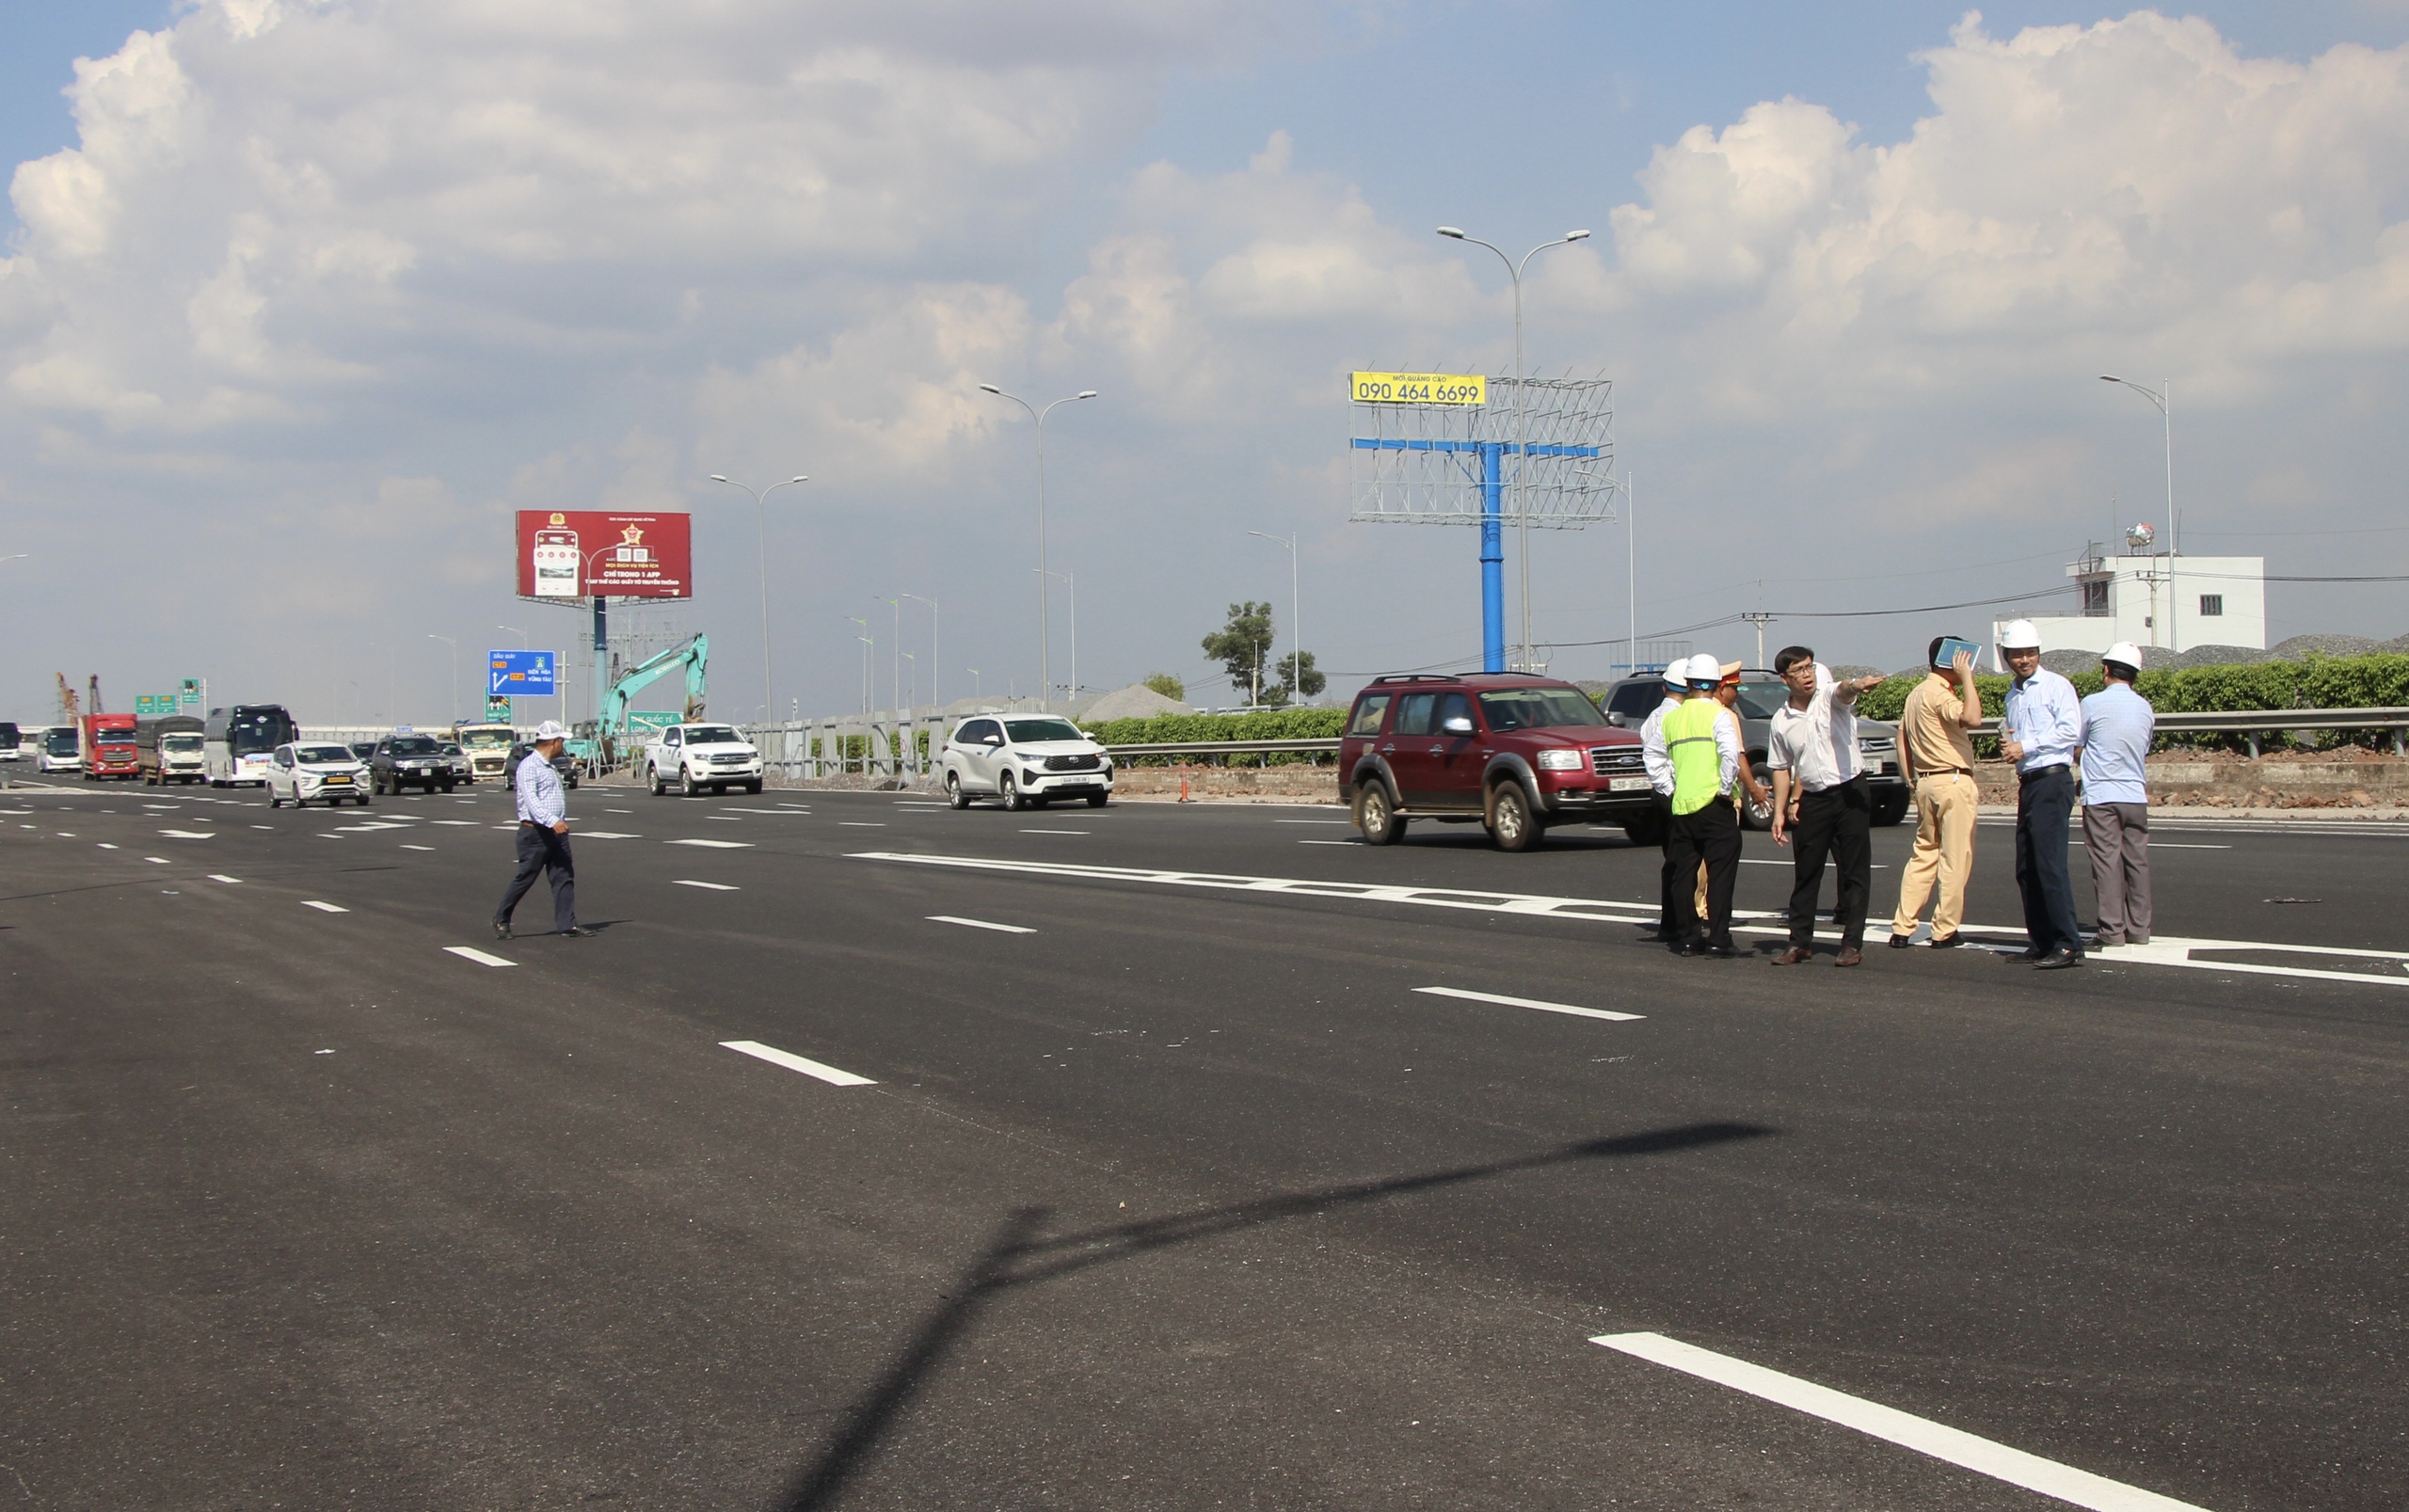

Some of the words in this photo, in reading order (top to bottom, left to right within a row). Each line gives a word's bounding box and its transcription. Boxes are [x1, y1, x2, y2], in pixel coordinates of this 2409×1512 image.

[1359, 383, 1391, 399] 090
[1397, 384, 1429, 400] 464
[1436, 385, 1478, 401] 6699
